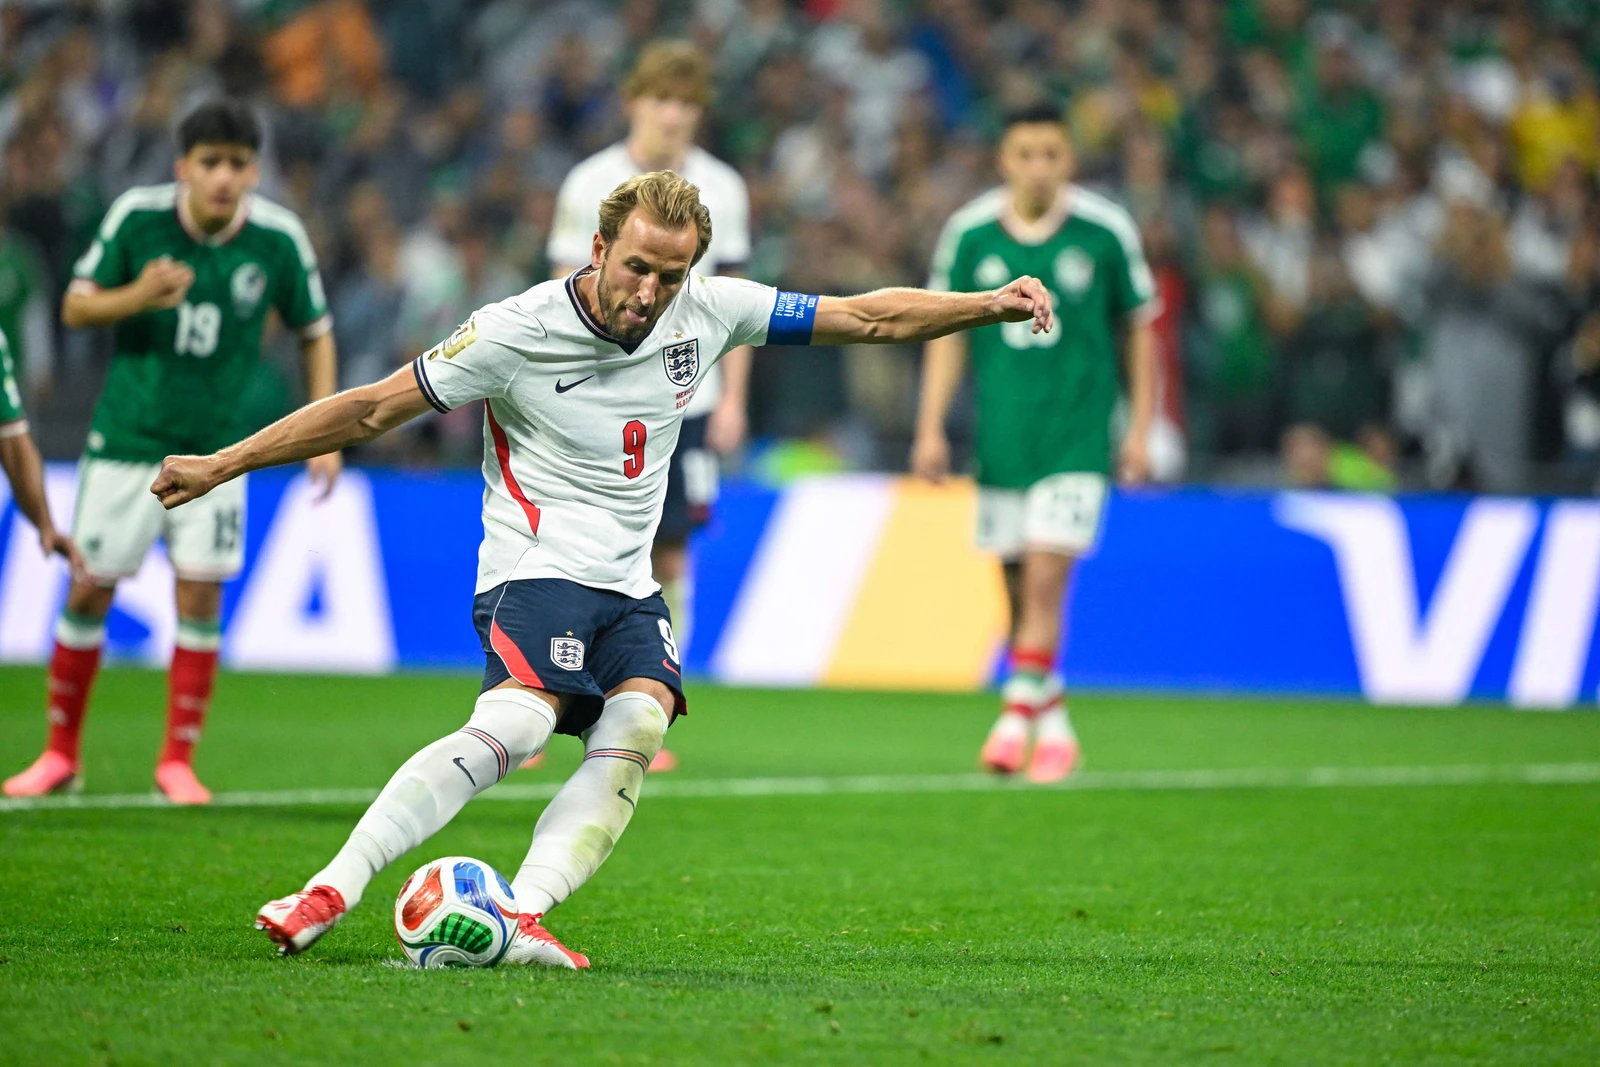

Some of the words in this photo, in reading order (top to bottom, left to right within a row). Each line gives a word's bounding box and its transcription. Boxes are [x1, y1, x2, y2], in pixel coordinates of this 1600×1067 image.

[175, 301, 220, 357] 19
[795, 305, 805, 320] the
[622, 419, 647, 479] 9
[1270, 493, 1600, 709] VI
[657, 617, 680, 665] 9
